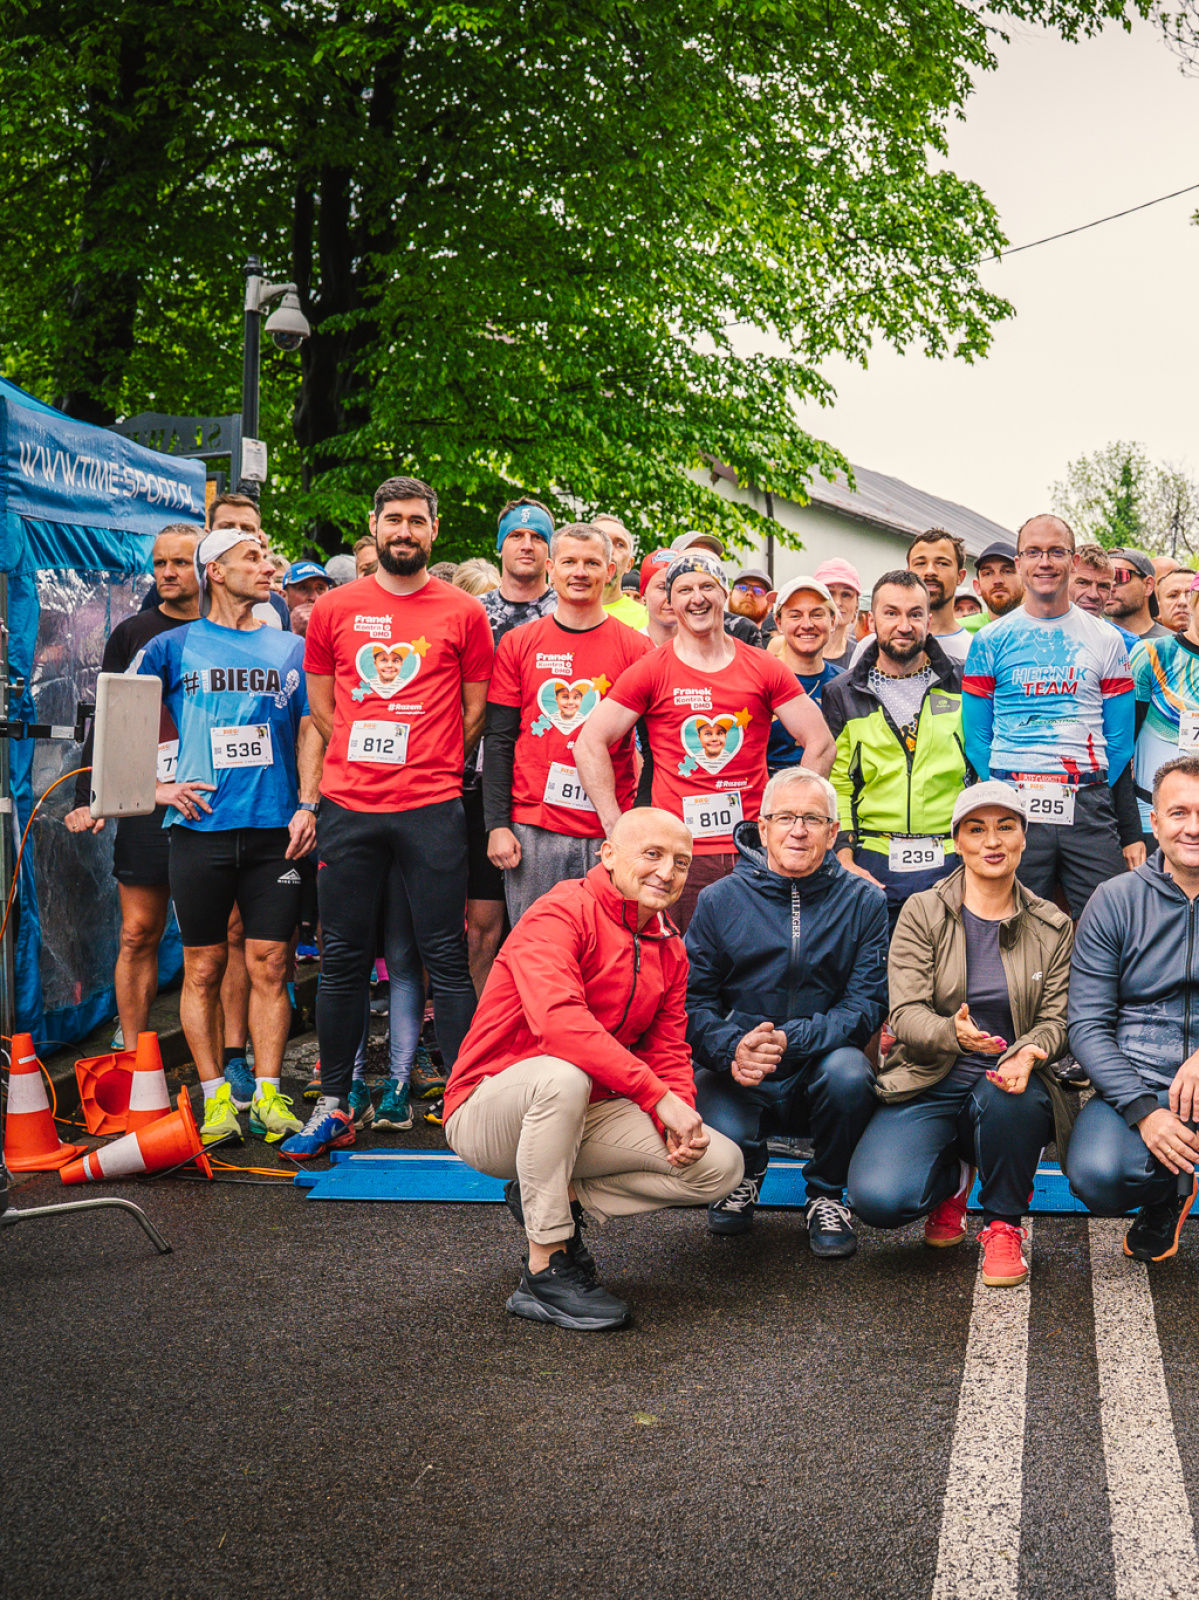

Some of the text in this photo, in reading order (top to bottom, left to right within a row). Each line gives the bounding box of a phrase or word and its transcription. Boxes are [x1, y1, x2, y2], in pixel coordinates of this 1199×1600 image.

[19, 441, 200, 514] WWW.TIME-SPORT.PL
[354, 614, 393, 624] Franek
[535, 652, 574, 662] Franek
[210, 668, 281, 692] BIEGA
[1011, 665, 1088, 686] HERNIK
[673, 686, 712, 696] Franek
[1022, 681, 1078, 697] TEAM
[226, 741, 262, 758] 536
[363, 737, 395, 754] 812
[1029, 798, 1064, 815] 295
[699, 810, 732, 828] 810
[902, 850, 935, 864] 239
[791, 891, 801, 939] HILFIGER
